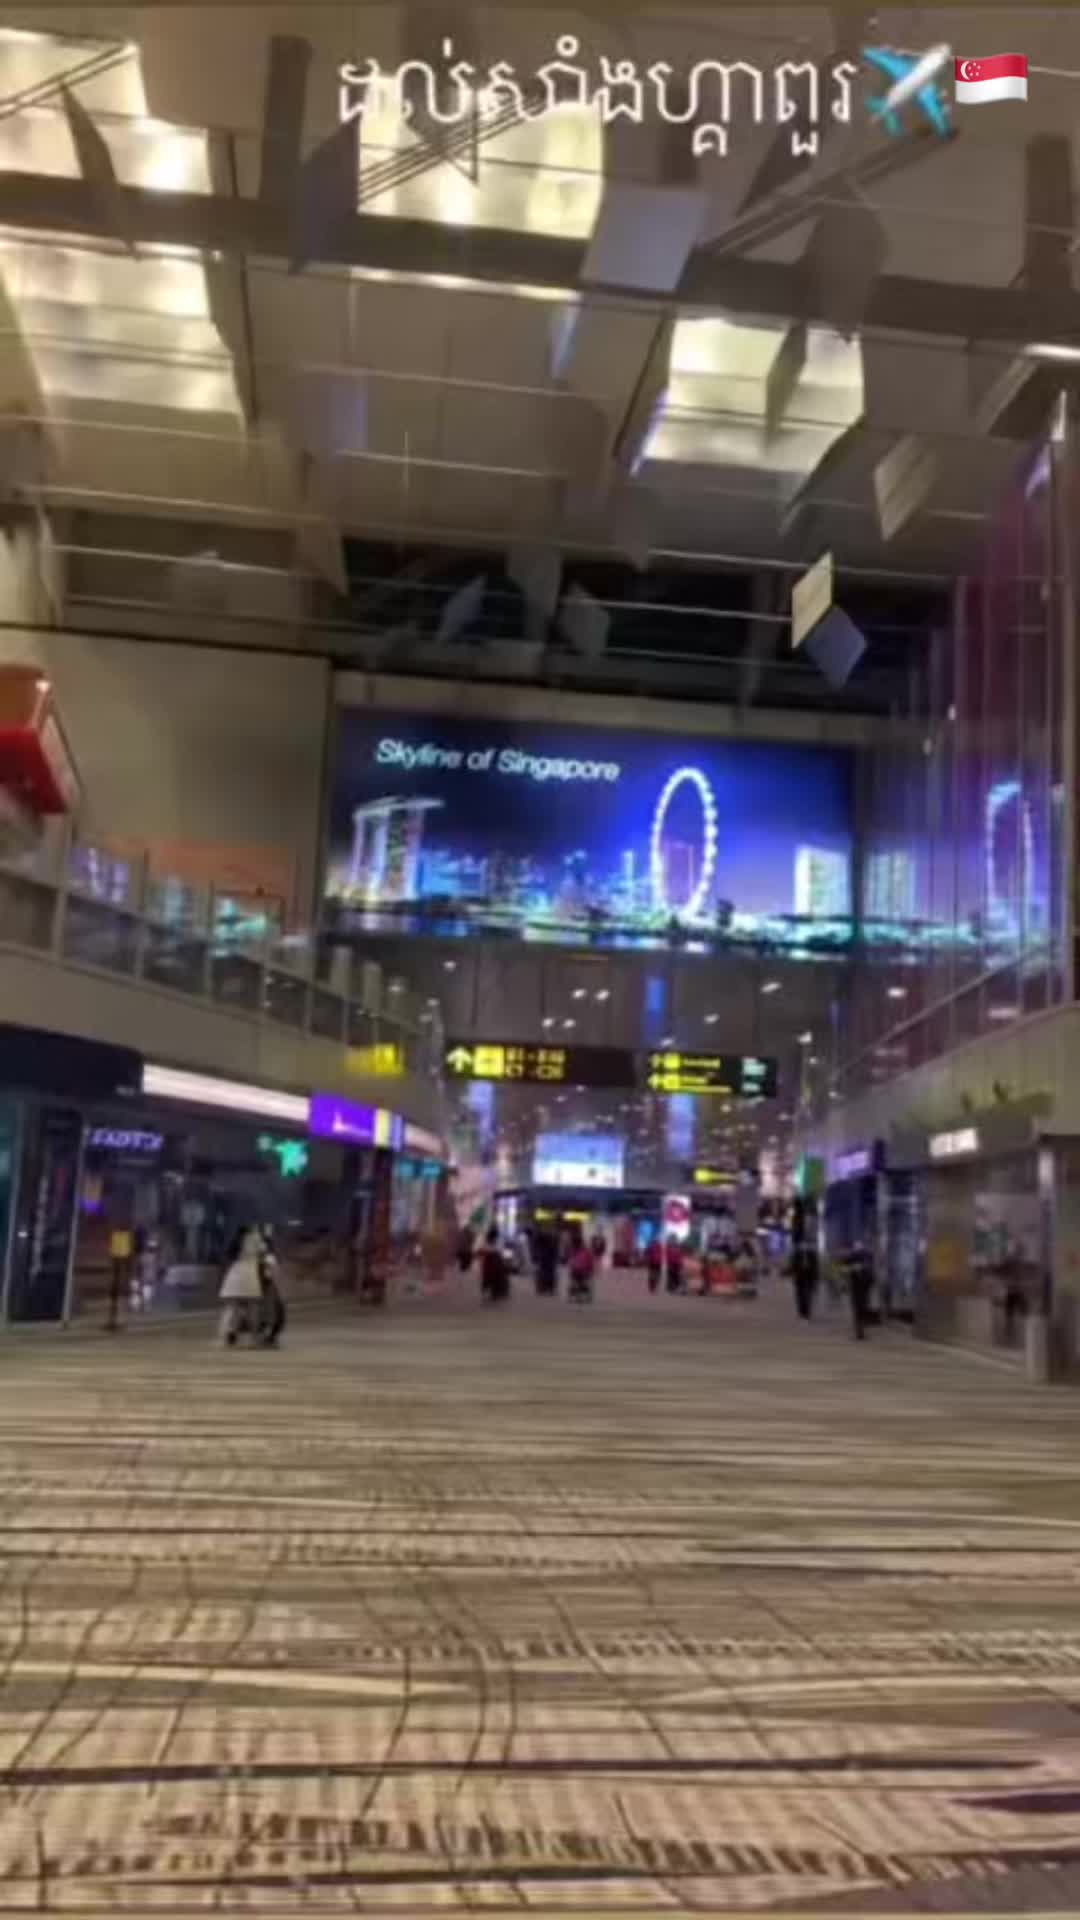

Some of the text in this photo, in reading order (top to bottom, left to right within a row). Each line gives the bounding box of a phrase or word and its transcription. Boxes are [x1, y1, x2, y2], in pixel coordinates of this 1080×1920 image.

[377, 738, 621, 781] Skyline of Singapore
